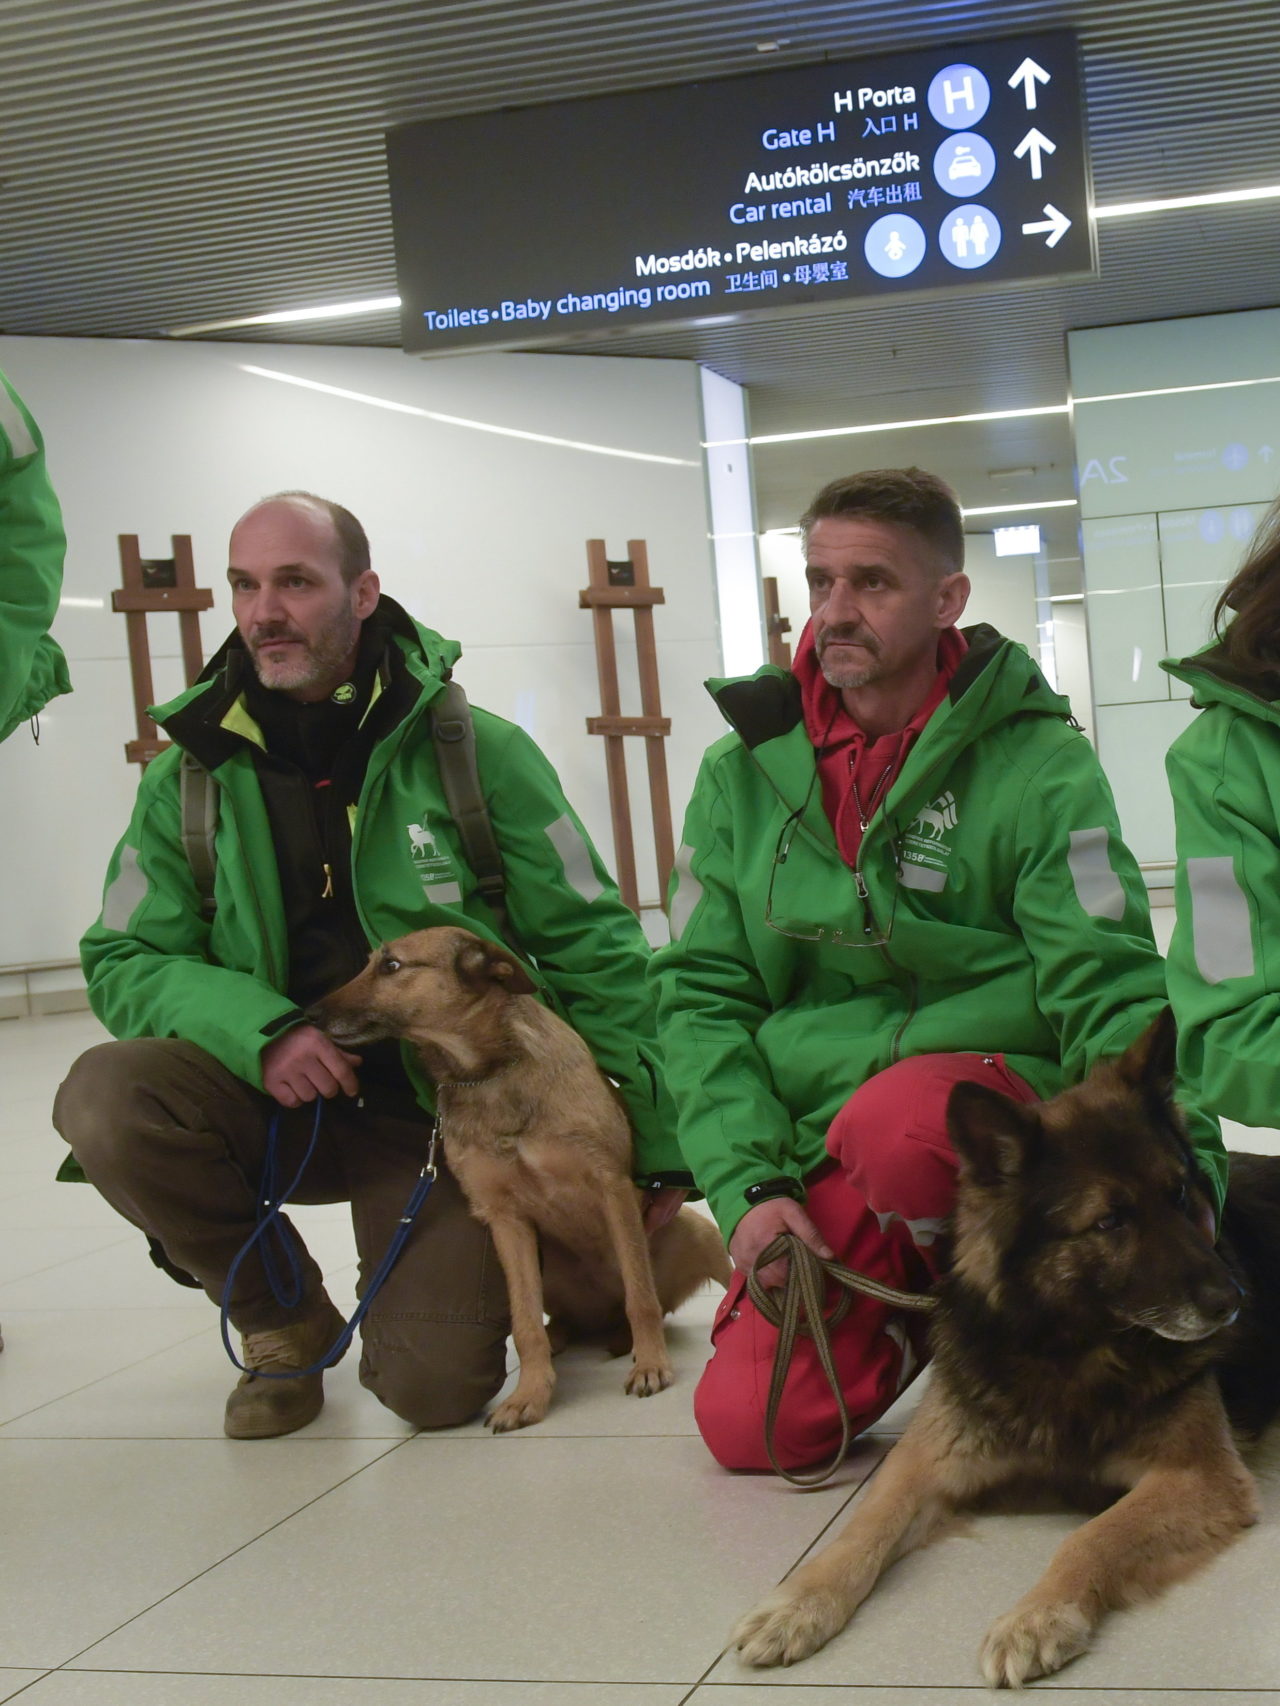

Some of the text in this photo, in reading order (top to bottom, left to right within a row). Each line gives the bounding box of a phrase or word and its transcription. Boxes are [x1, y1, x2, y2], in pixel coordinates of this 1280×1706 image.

[833, 85, 916, 113] H Porta
[943, 76, 975, 114] H
[762, 121, 836, 150] Gate H
[862, 112, 919, 138] 入口 H
[744, 151, 920, 193] Autókölcsönzők
[729, 192, 832, 225] Car rental
[847, 181, 922, 209] 汽车出租
[635, 230, 848, 276] Mosdók Pelenkázó
[424, 280, 711, 330] Toilets Baby changing room
